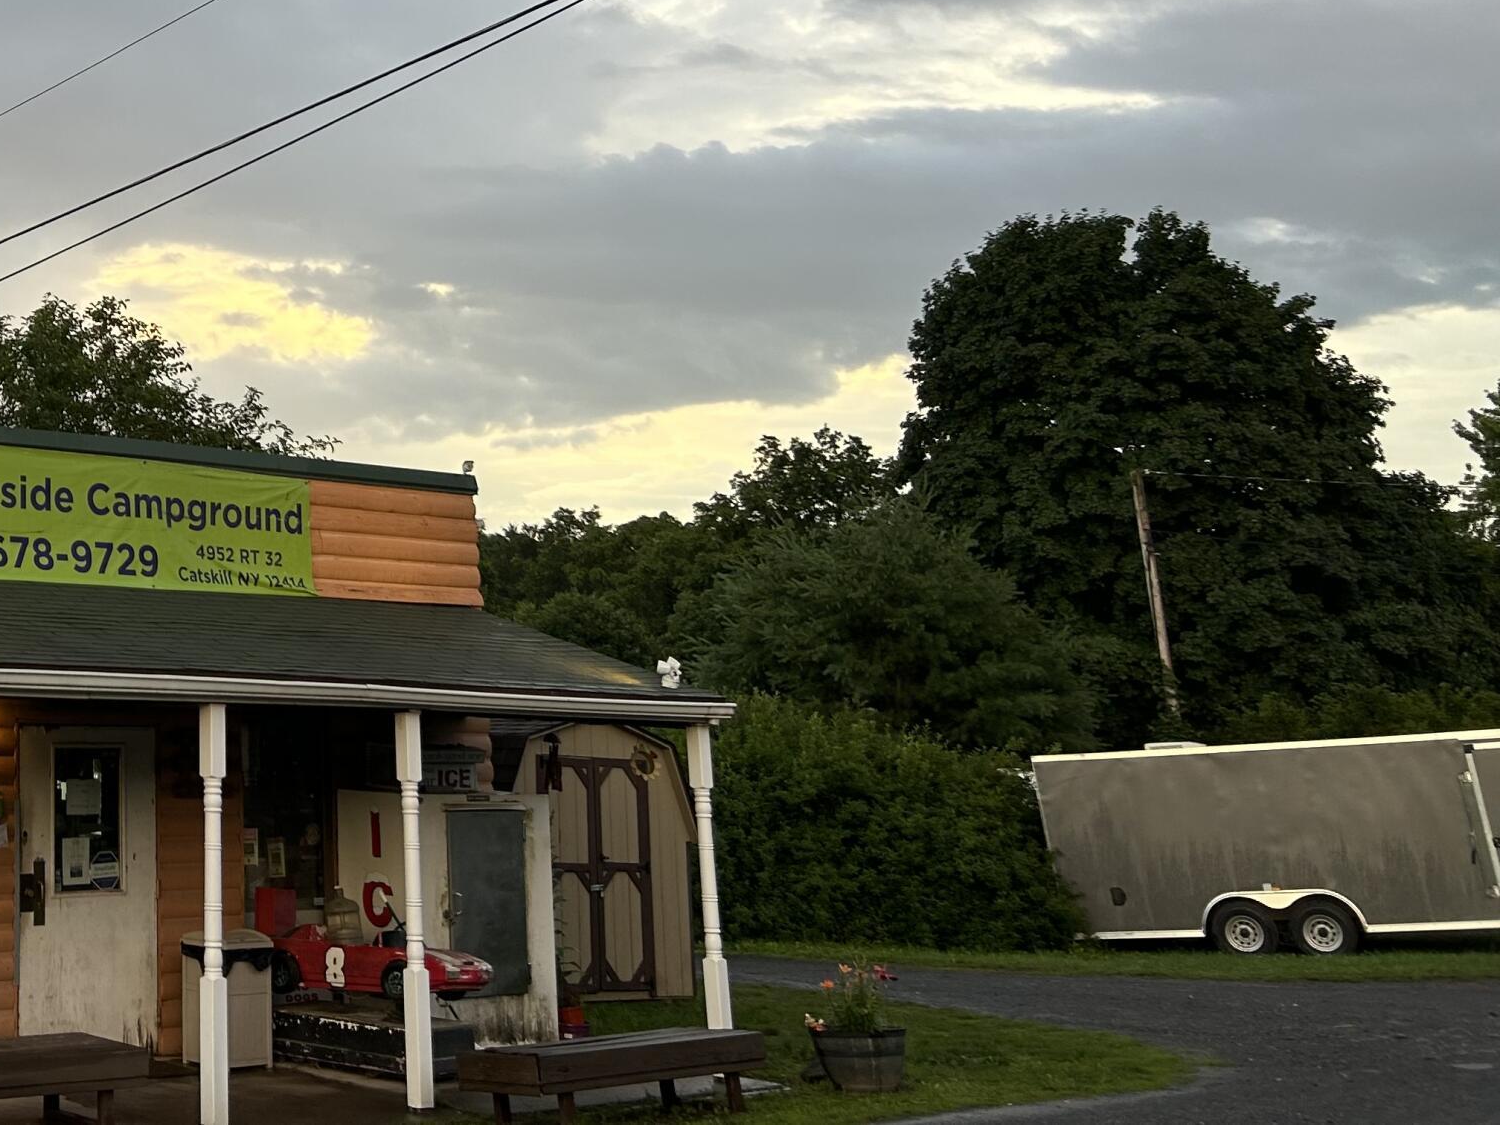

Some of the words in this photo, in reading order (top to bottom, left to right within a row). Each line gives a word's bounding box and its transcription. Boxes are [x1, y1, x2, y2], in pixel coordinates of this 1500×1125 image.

[88, 483, 303, 535] Campground
[196, 544, 235, 562] 4952
[240, 549, 259, 564] RT
[265, 552, 282, 567] 32
[178, 566, 233, 585] Catskill
[238, 571, 260, 586] NY
[437, 770, 471, 788] ICE
[325, 946, 345, 987] 8
